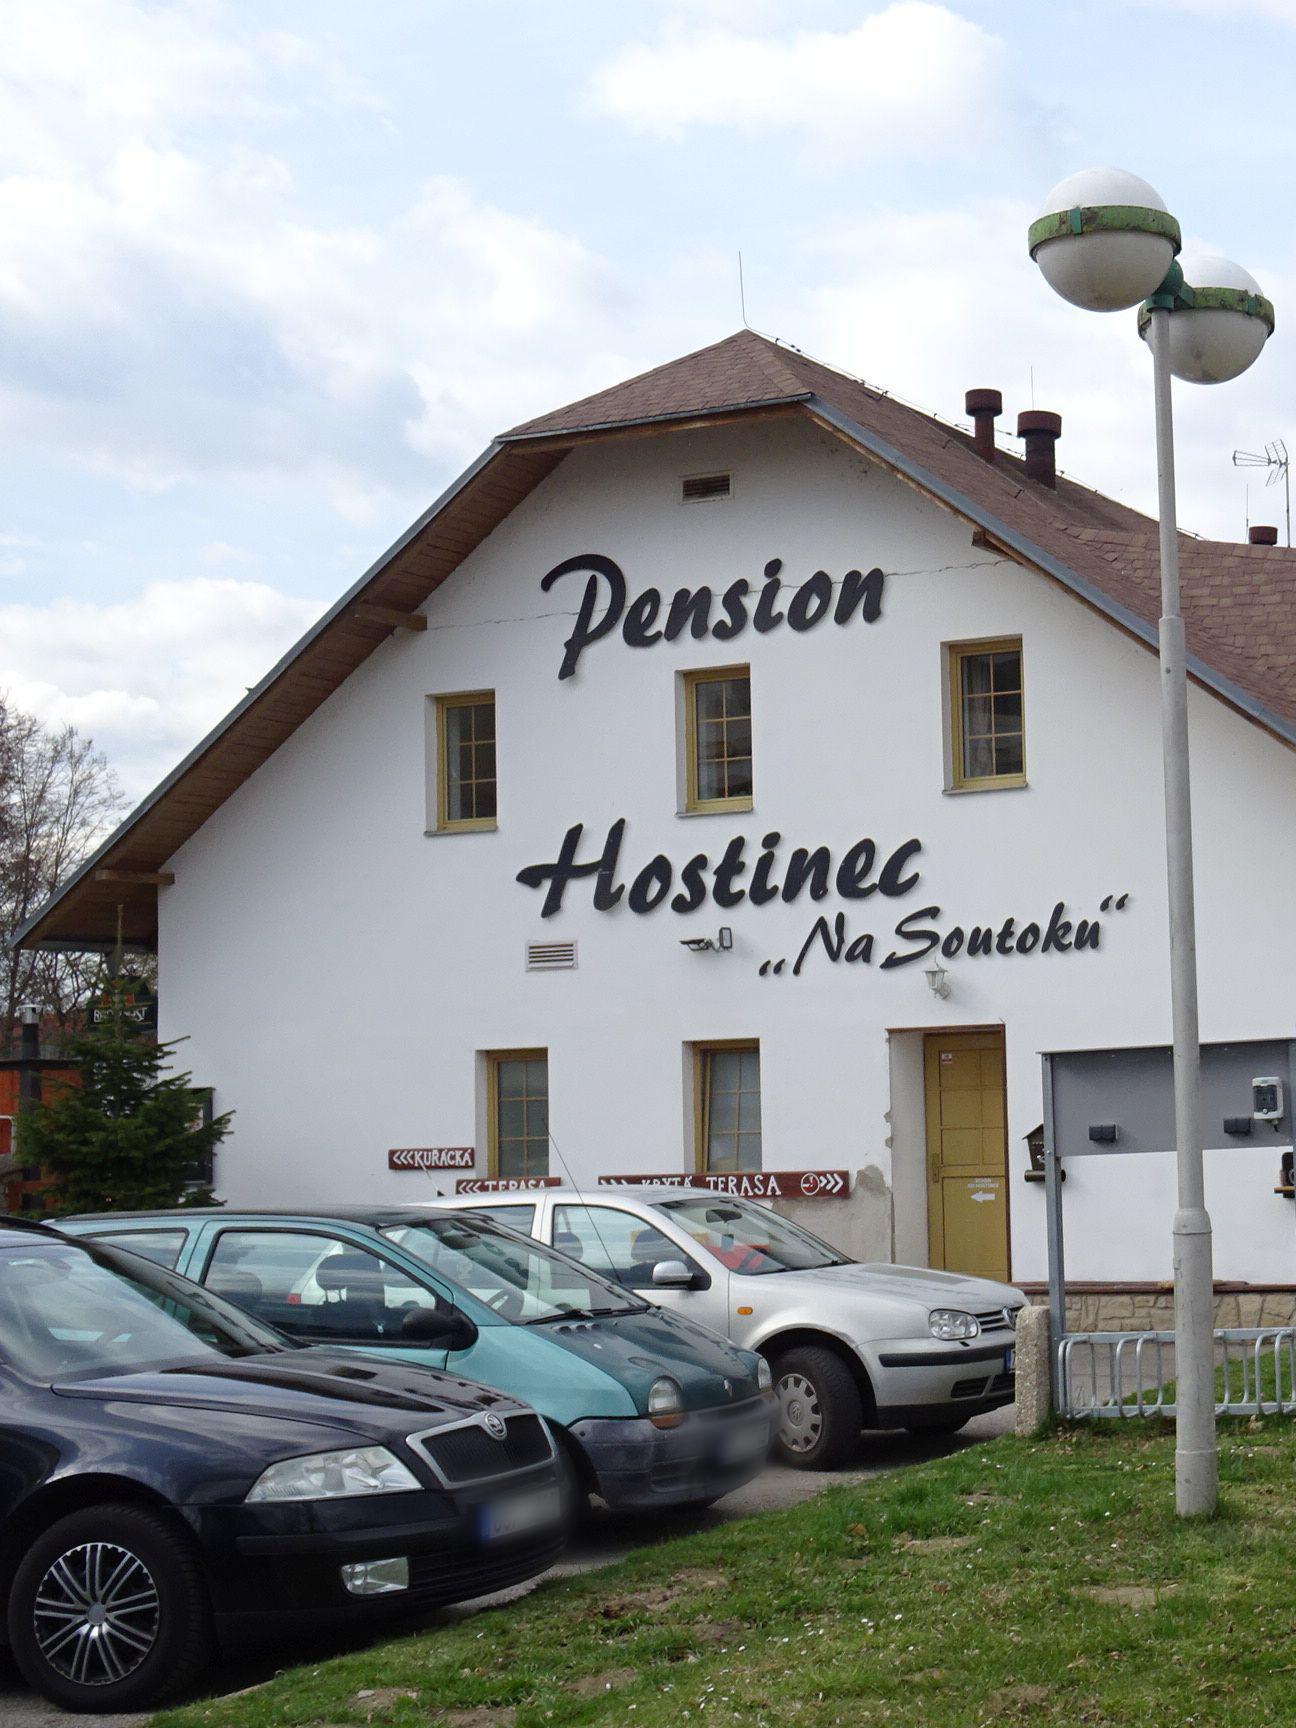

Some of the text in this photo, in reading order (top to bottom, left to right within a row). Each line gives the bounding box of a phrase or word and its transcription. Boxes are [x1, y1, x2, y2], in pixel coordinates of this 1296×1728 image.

[540, 552, 885, 681] Pension
[515, 816, 923, 919] Hostinec
[705, 1174, 782, 1197] TERASA
